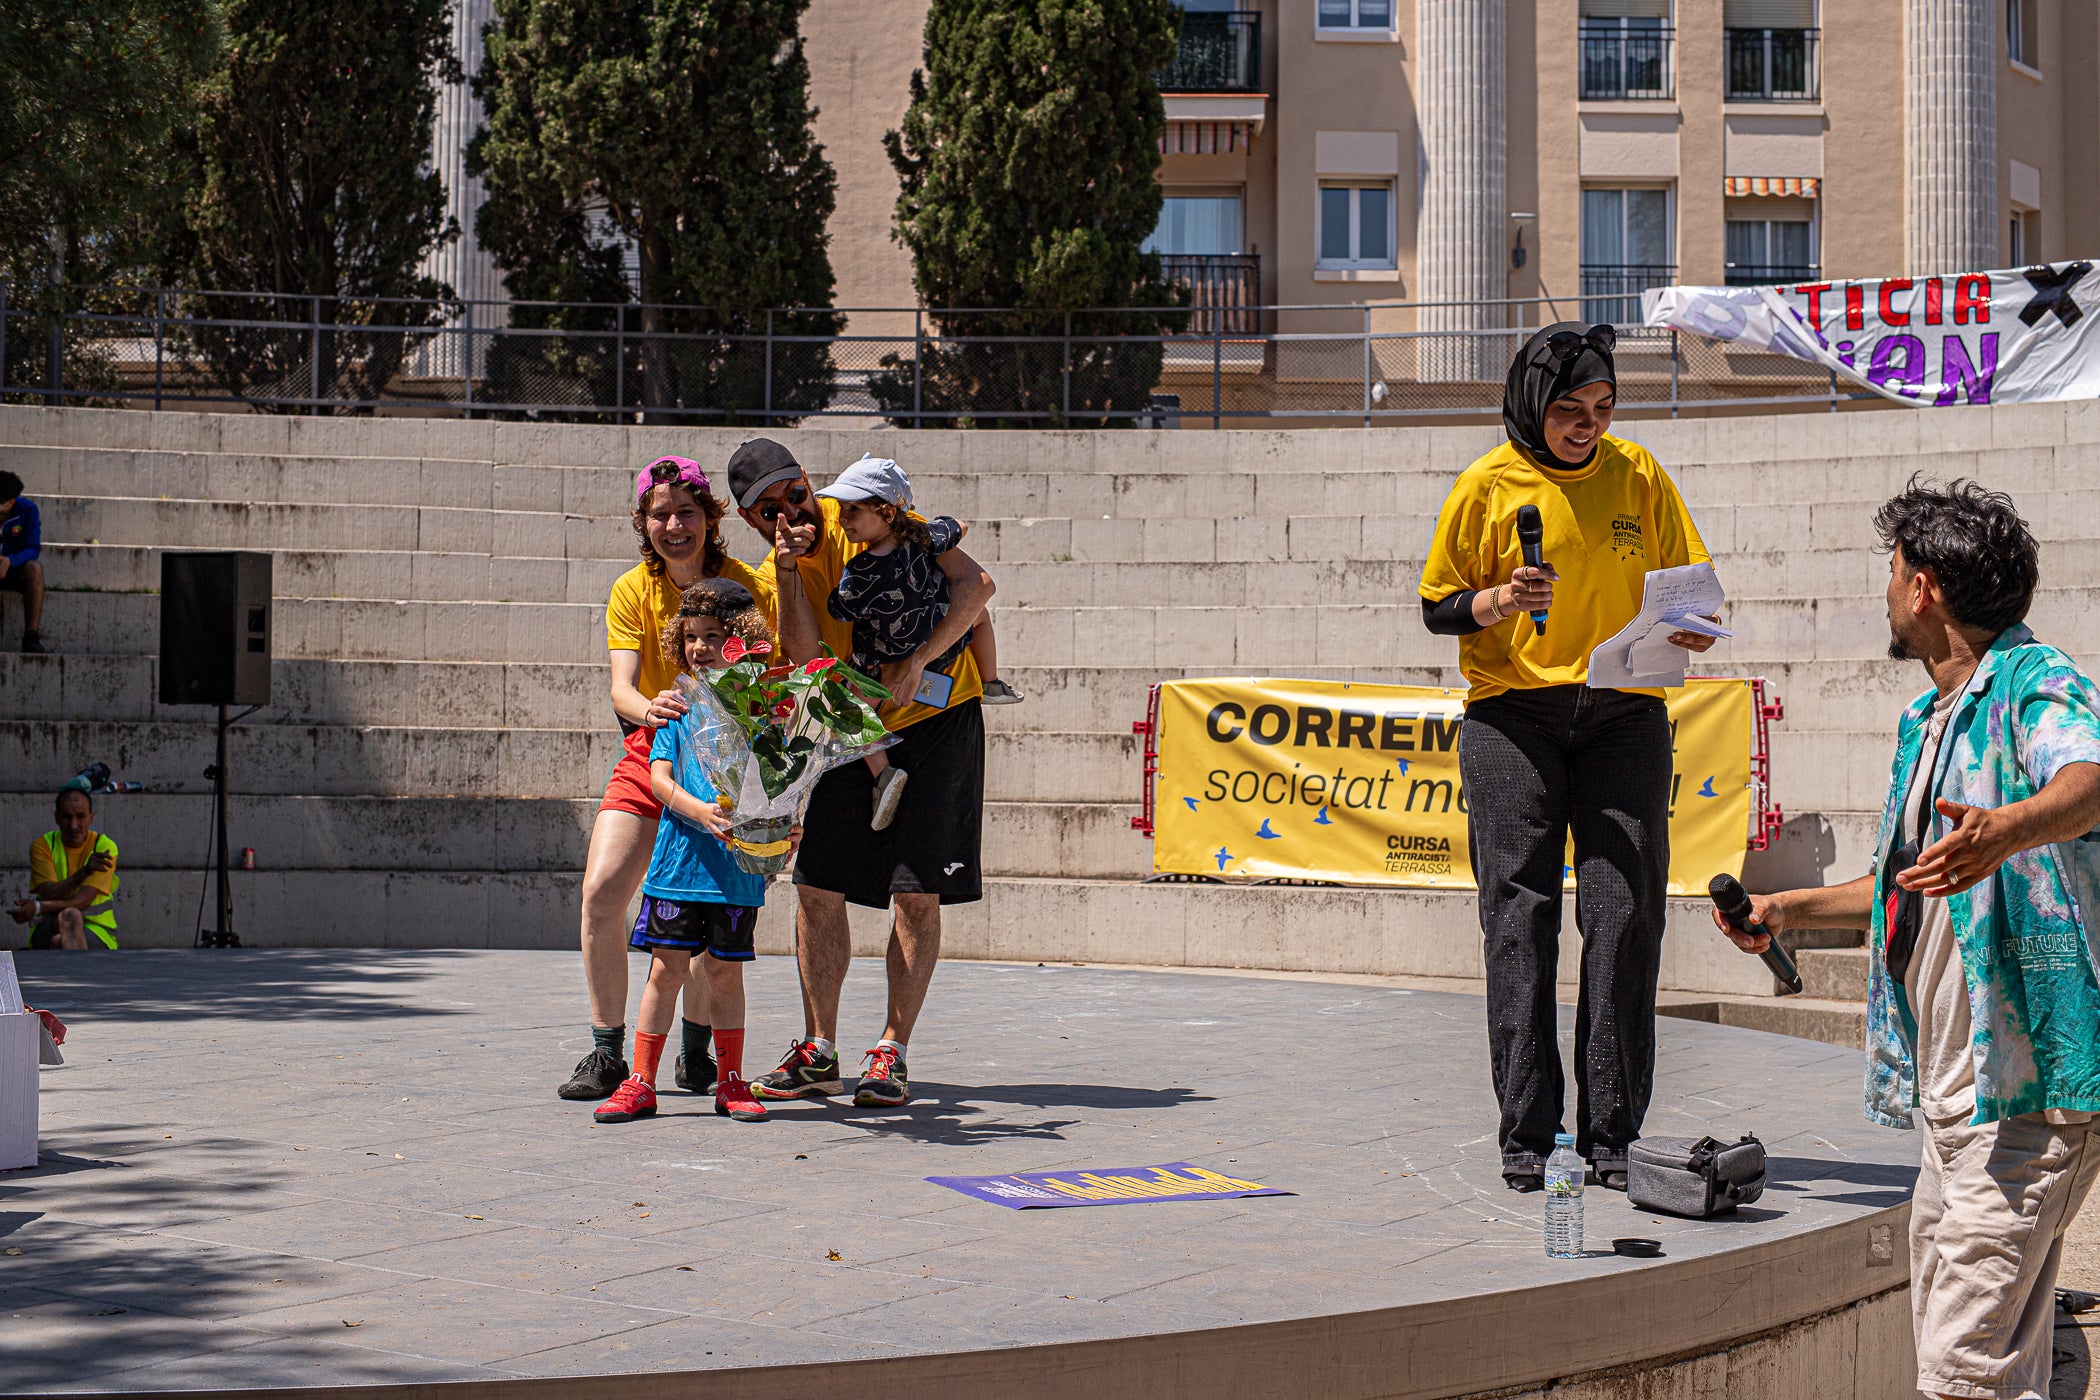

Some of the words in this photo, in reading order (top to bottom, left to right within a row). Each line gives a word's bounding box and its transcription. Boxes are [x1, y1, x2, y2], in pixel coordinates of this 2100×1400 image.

[1776, 272, 1992, 333] TICIA
[1612, 520, 1642, 535] CURSA
[1206, 701, 1463, 753] CORREM
[1204, 762, 1394, 810] societat
[1387, 834, 1451, 852] CURSA
[1386, 851, 1451, 863] ANTIRACISTA
[1385, 861, 1452, 875] TERRASSA
[2002, 933, 2078, 957] FUTURE
